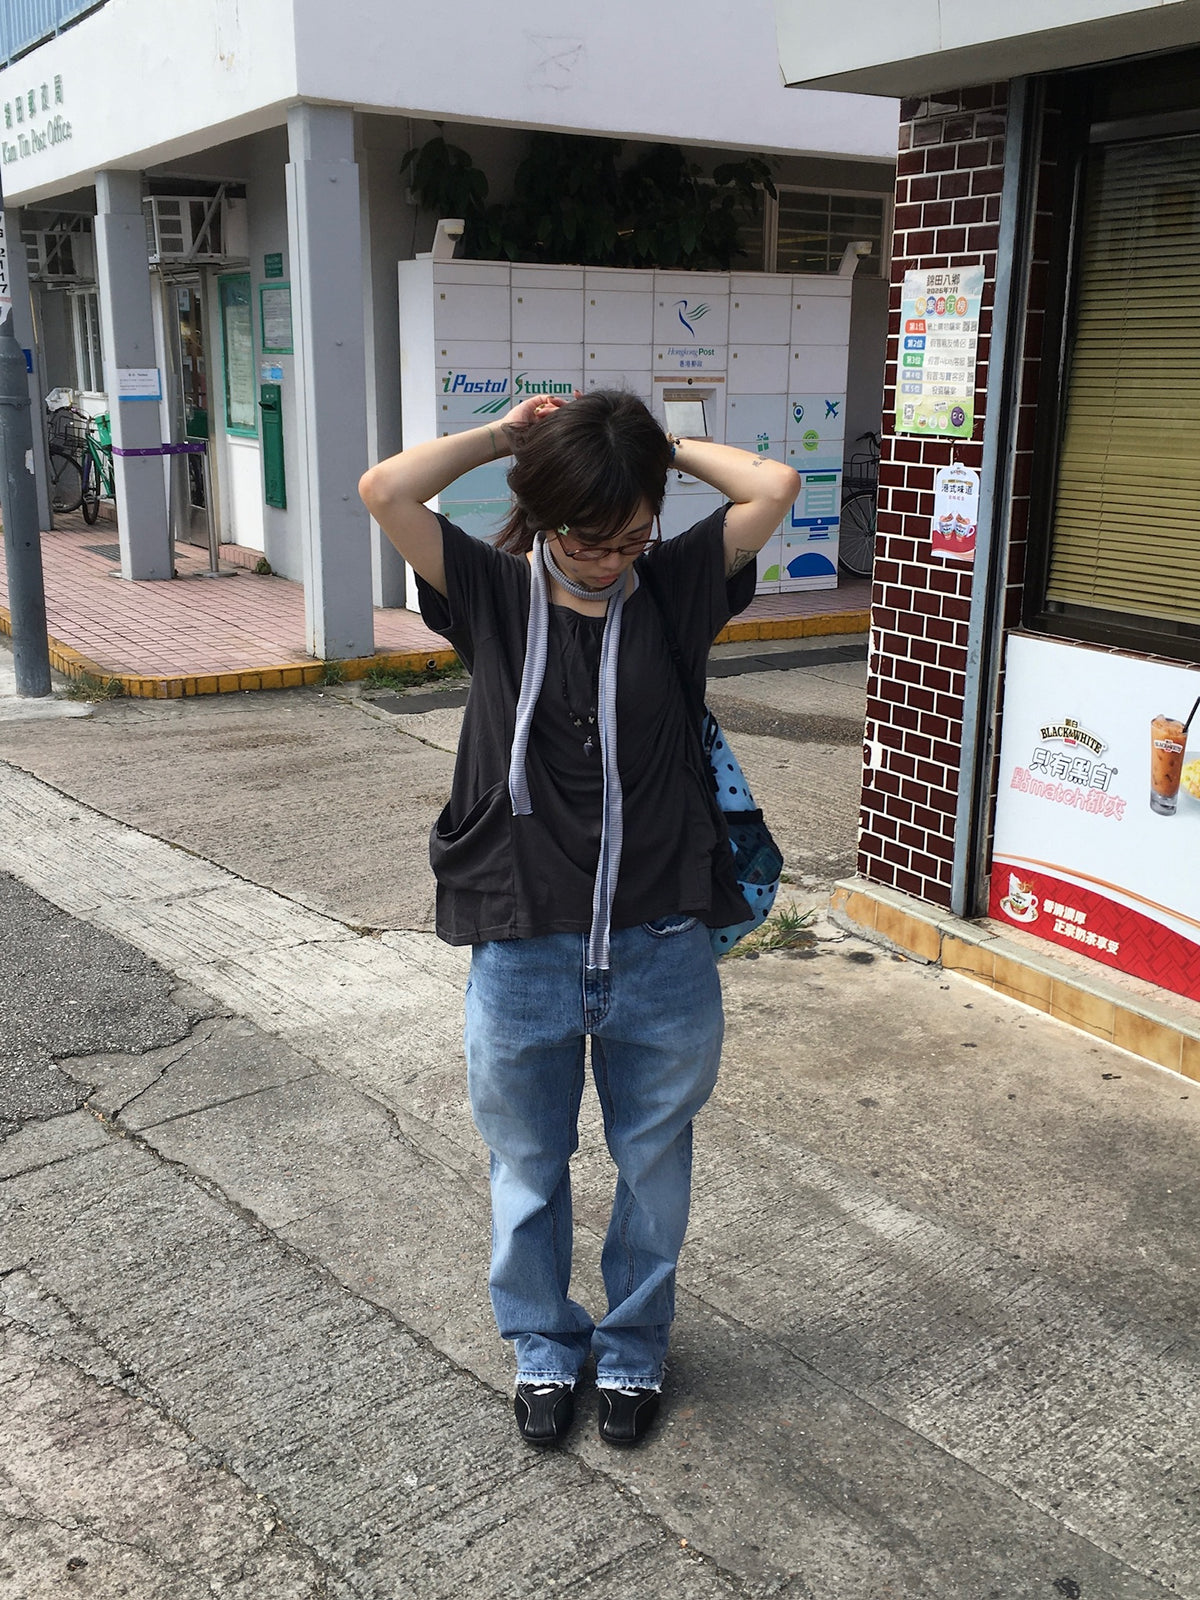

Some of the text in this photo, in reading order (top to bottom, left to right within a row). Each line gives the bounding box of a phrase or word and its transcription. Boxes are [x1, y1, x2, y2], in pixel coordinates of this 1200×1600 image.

[17, 133, 31, 158] Tin
[31, 129, 47, 153] Post
[47, 114, 72, 146] Office
[926, 273, 961, 287] 錦田八鄉
[443, 371, 572, 395] iPostal Station
[1040, 726, 1103, 754] BLACK&WHITE
